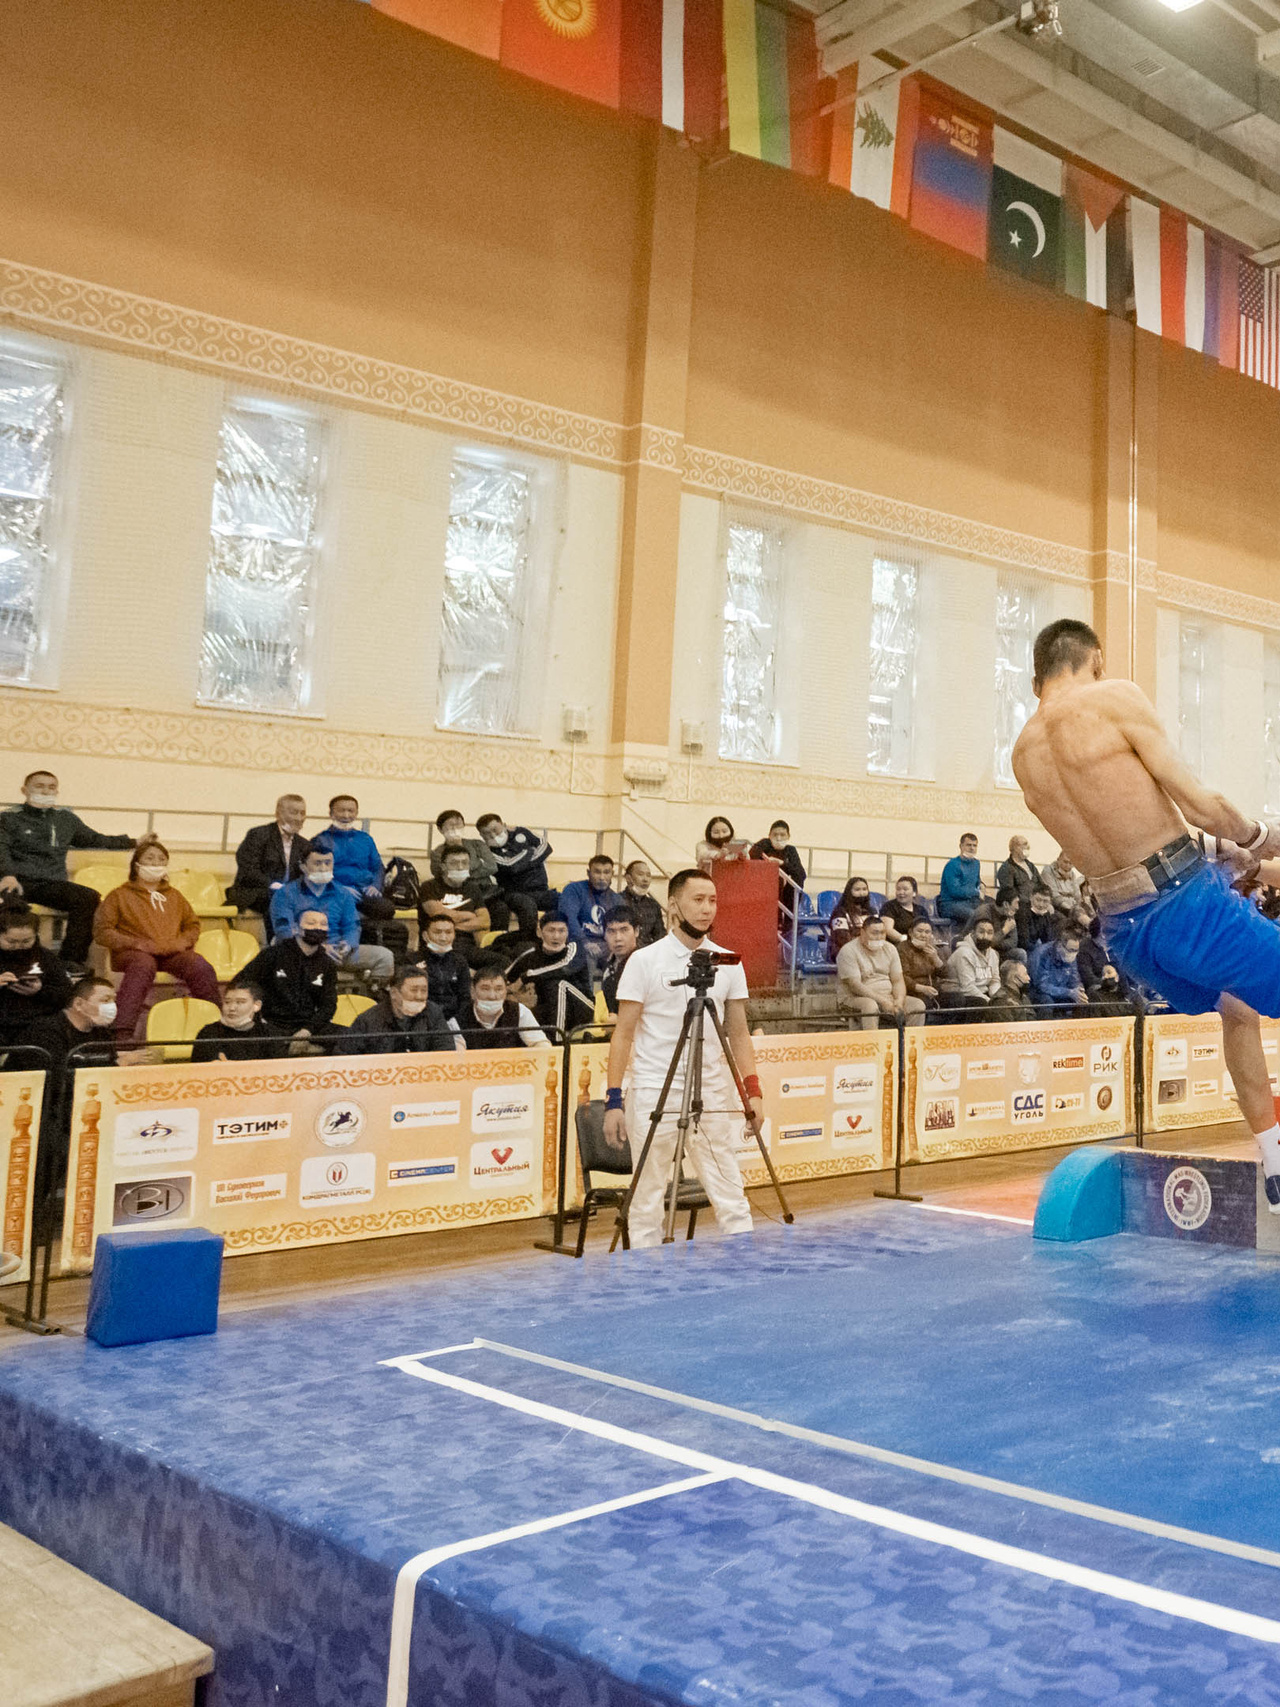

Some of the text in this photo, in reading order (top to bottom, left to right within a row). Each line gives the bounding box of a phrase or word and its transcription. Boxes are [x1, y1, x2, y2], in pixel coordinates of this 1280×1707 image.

[1094, 1062, 1118, 1073] РИК
[1014, 1094, 1044, 1111] СДС
[476, 1103, 529, 1118] Якутия
[1014, 1111, 1044, 1120] УГОЛЬ
[217, 1120, 279, 1135] ТЭТИМ
